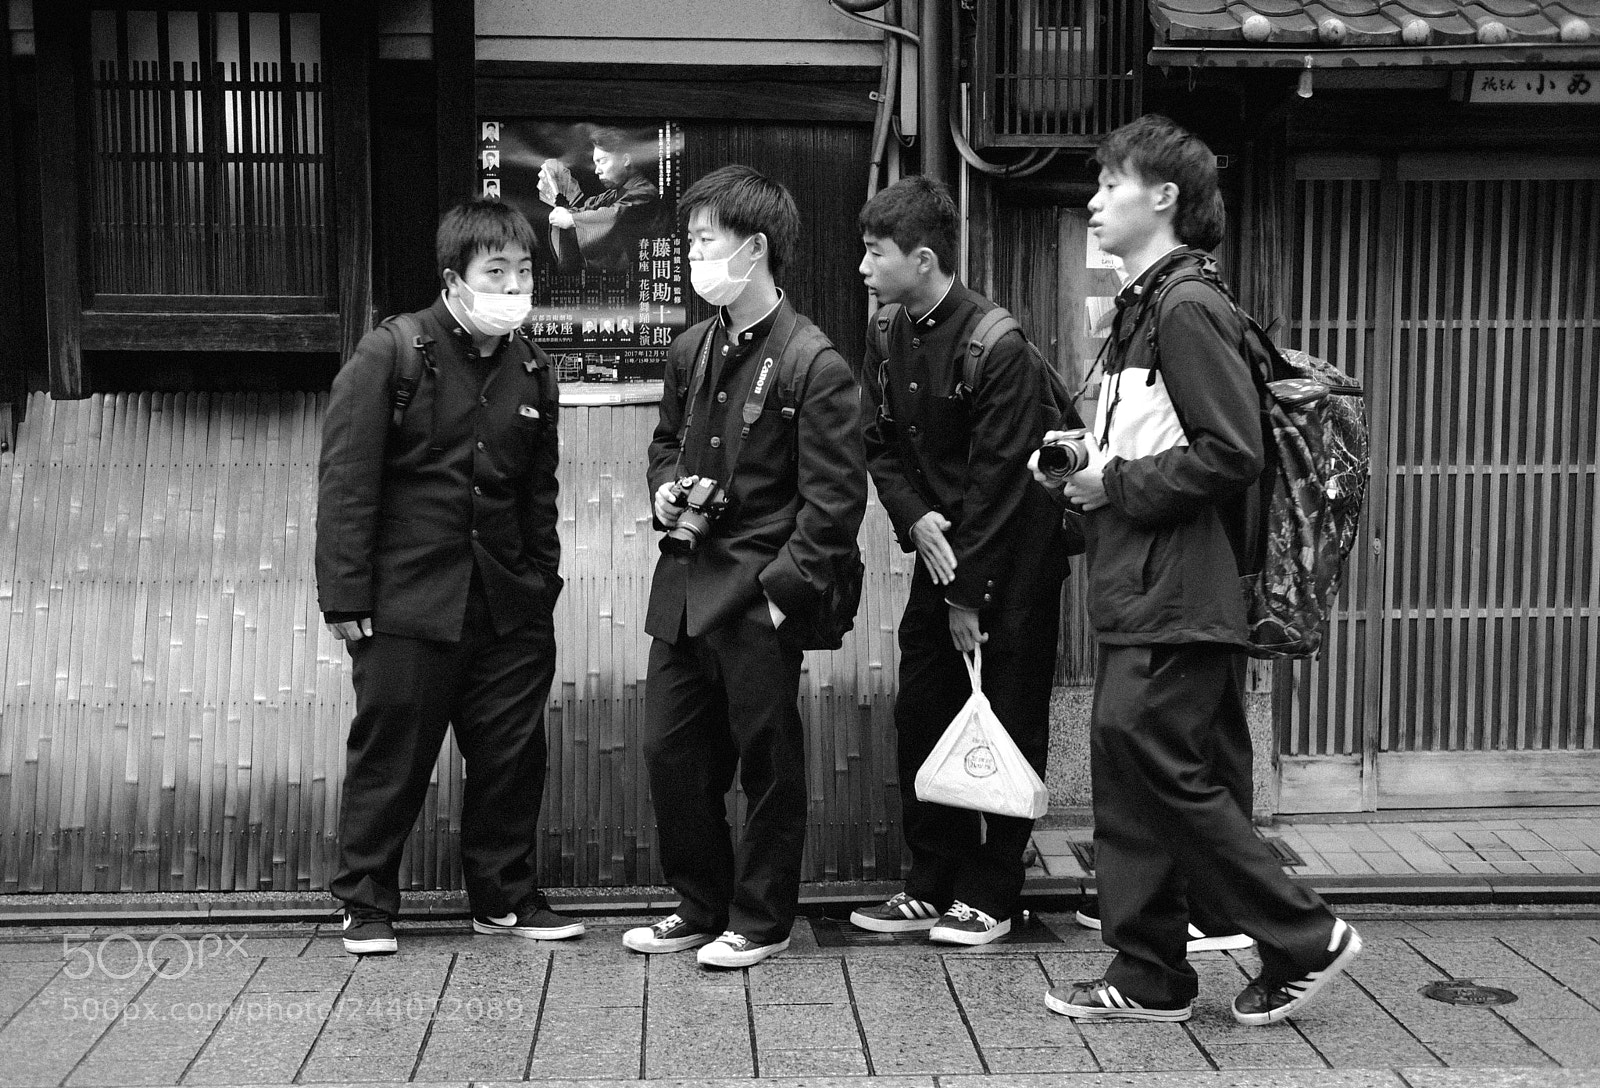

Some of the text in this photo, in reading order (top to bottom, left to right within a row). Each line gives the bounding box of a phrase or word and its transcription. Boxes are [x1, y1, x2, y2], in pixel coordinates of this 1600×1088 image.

[638, 238, 651, 346] 春秋座 花形舞踊公演
[651, 237, 672, 346] 藤間勘十郎
[531, 322, 574, 336] 春秋座
[754, 357, 774, 395] Canon
